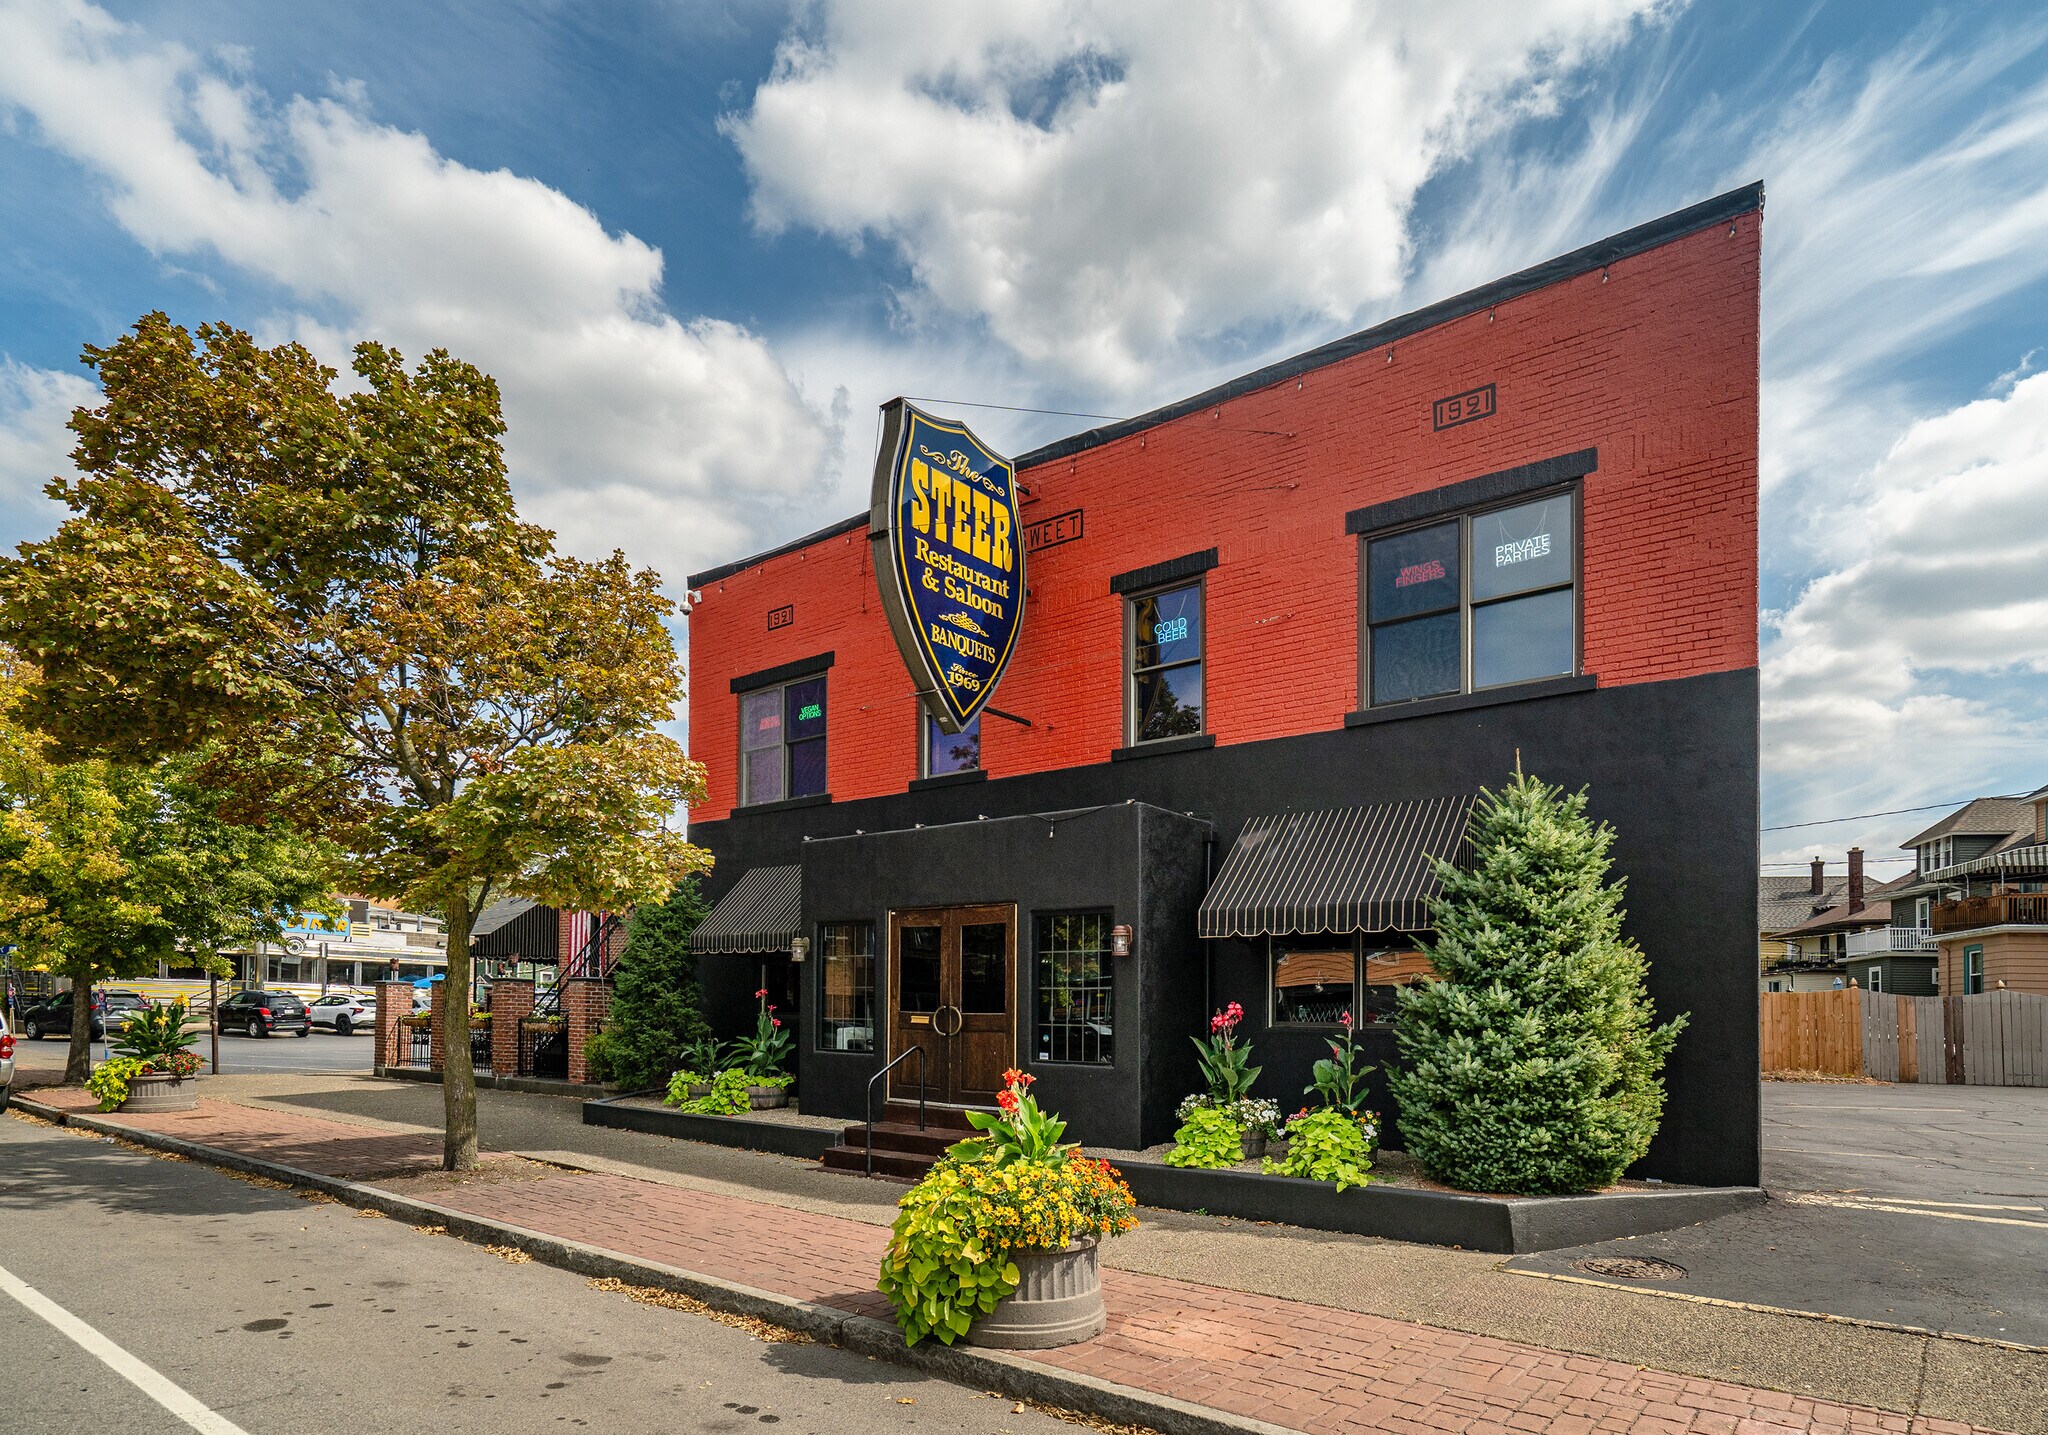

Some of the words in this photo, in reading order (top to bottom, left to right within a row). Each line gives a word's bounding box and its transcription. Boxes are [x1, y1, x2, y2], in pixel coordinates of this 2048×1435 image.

[1440, 391, 1489, 423] 1921
[946, 450, 983, 483] The
[911, 457, 1013, 572] STEER
[1496, 533, 1550, 557] PRIVATE
[1496, 544, 1550, 567] PARTIES
[914, 536, 1010, 599] Restaurant
[1396, 568, 1446, 588] FINGERS
[1400, 560, 1440, 577] WINGS
[921, 567, 940, 592] &
[944, 576, 1004, 620] Saloon
[1154, 617, 1187, 635] COLD
[1157, 627, 1187, 644] BEER
[931, 623, 996, 664] BANQUETS
[951, 663, 979, 678] Since
[947, 671, 981, 692] 1969
[798, 710, 821, 720] OPTIONS
[801, 704, 819, 714] VEGAN
[286, 917, 348, 932] INR
